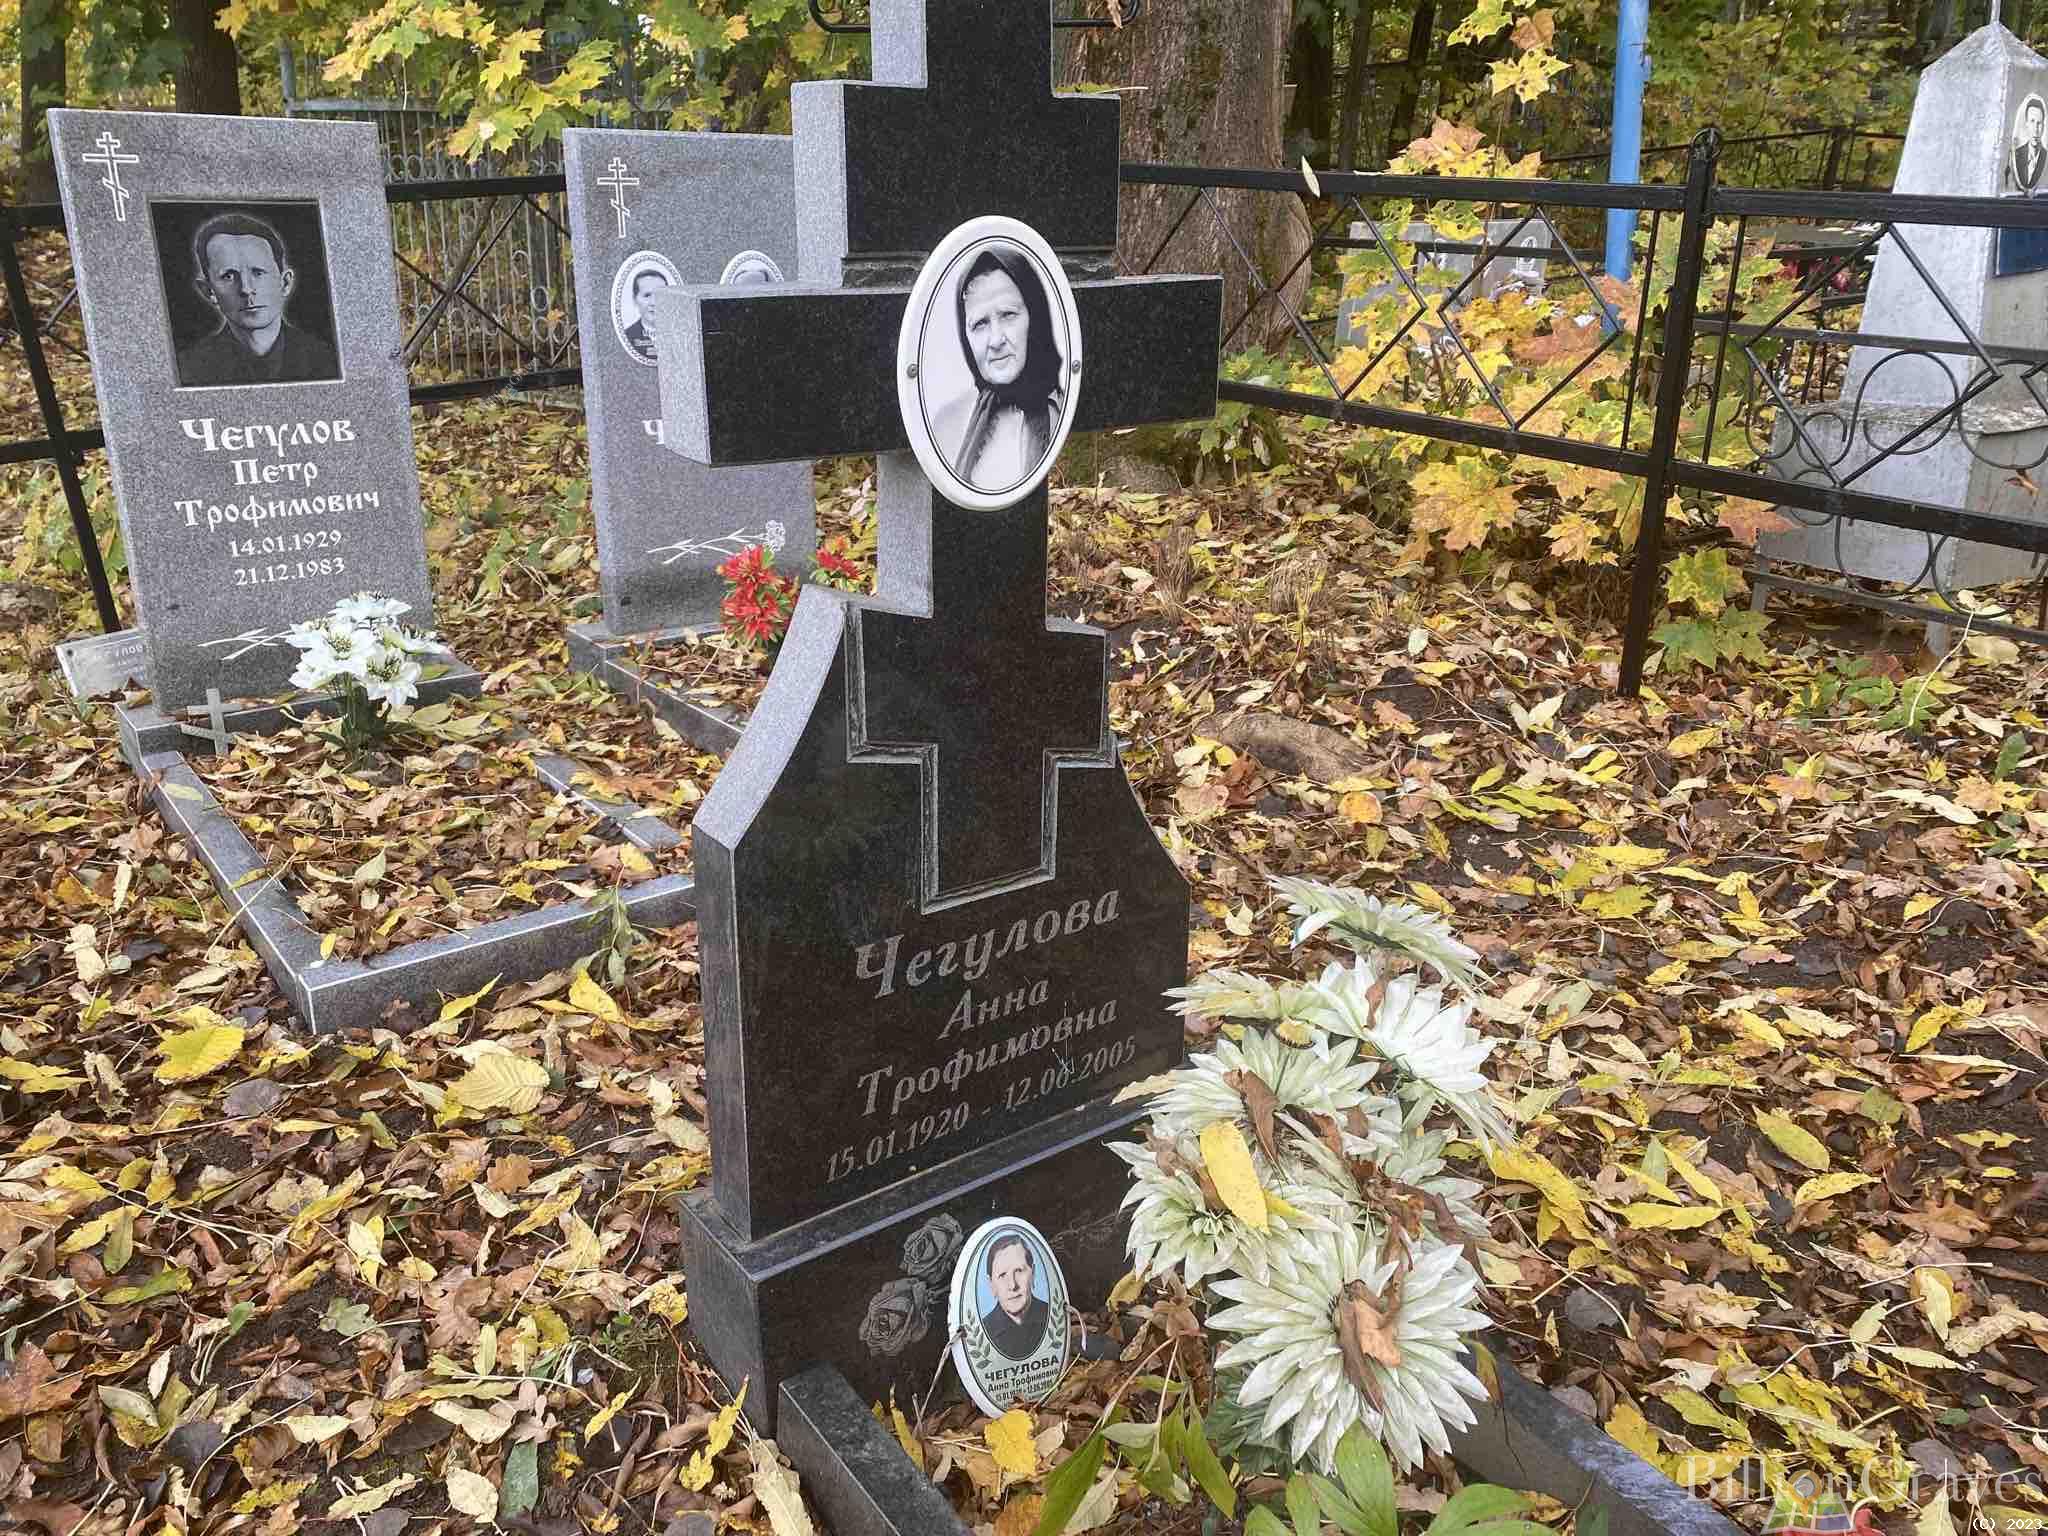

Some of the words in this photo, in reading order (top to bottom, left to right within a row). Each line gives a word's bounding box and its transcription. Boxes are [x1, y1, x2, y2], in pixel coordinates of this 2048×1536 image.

[179, 418, 355, 457] Чегулов
[231, 458, 318, 487] Петр
[174, 490, 380, 532] Трофимович
[229, 529, 342, 558] 14.01.1929
[234, 556, 345, 586] 21.12.1983
[855, 889, 1120, 999] Чегулова
[937, 979, 1049, 1040] Анна
[857, 1000, 1117, 1117] Трофимовна
[825, 1101, 970, 1184] 15.01.1920
[984, 1354, 1059, 1382] ЧЕГУЛОВА
[988, 1382, 1009, 1393] Анна
